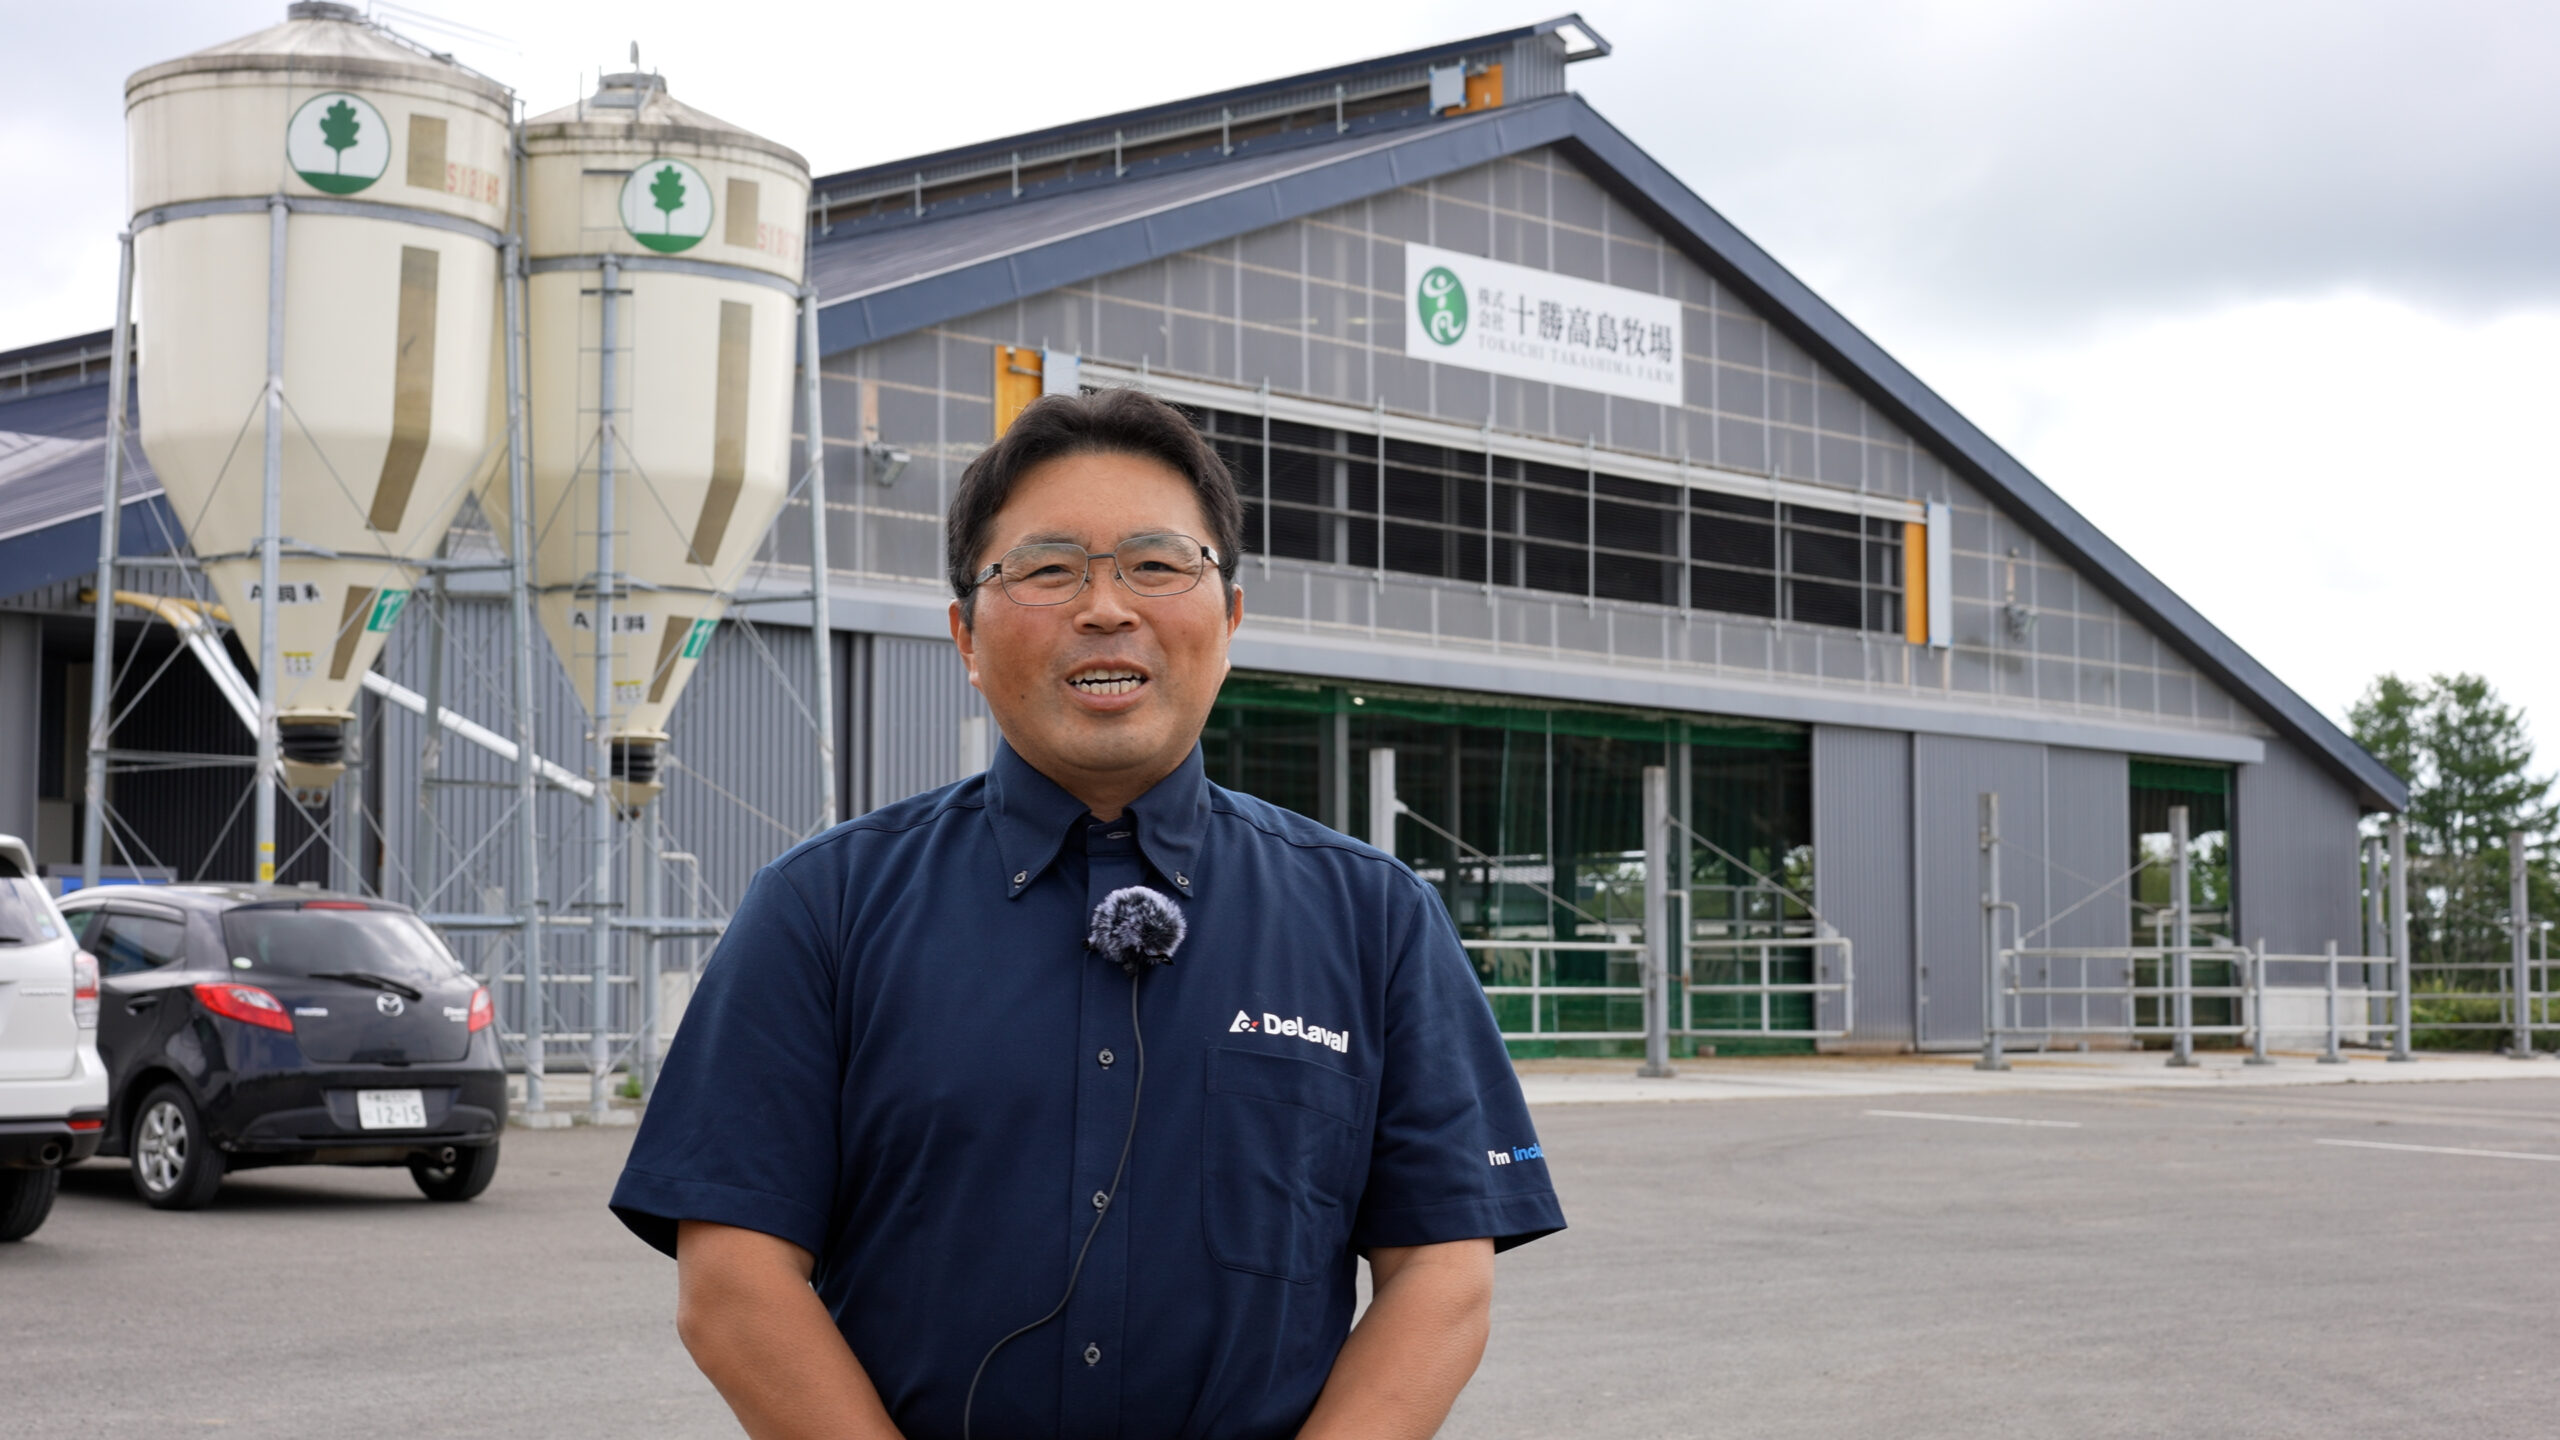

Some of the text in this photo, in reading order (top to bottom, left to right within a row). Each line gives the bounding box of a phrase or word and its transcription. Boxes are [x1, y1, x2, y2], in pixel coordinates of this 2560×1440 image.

[1508, 293, 1673, 364] 十勝高島牧場
[1478, 333, 1675, 385] TOKACHI TAKASHIMA FARM
[1262, 1012, 1349, 1054] DeLaval
[1487, 1150, 1511, 1166] I'm
